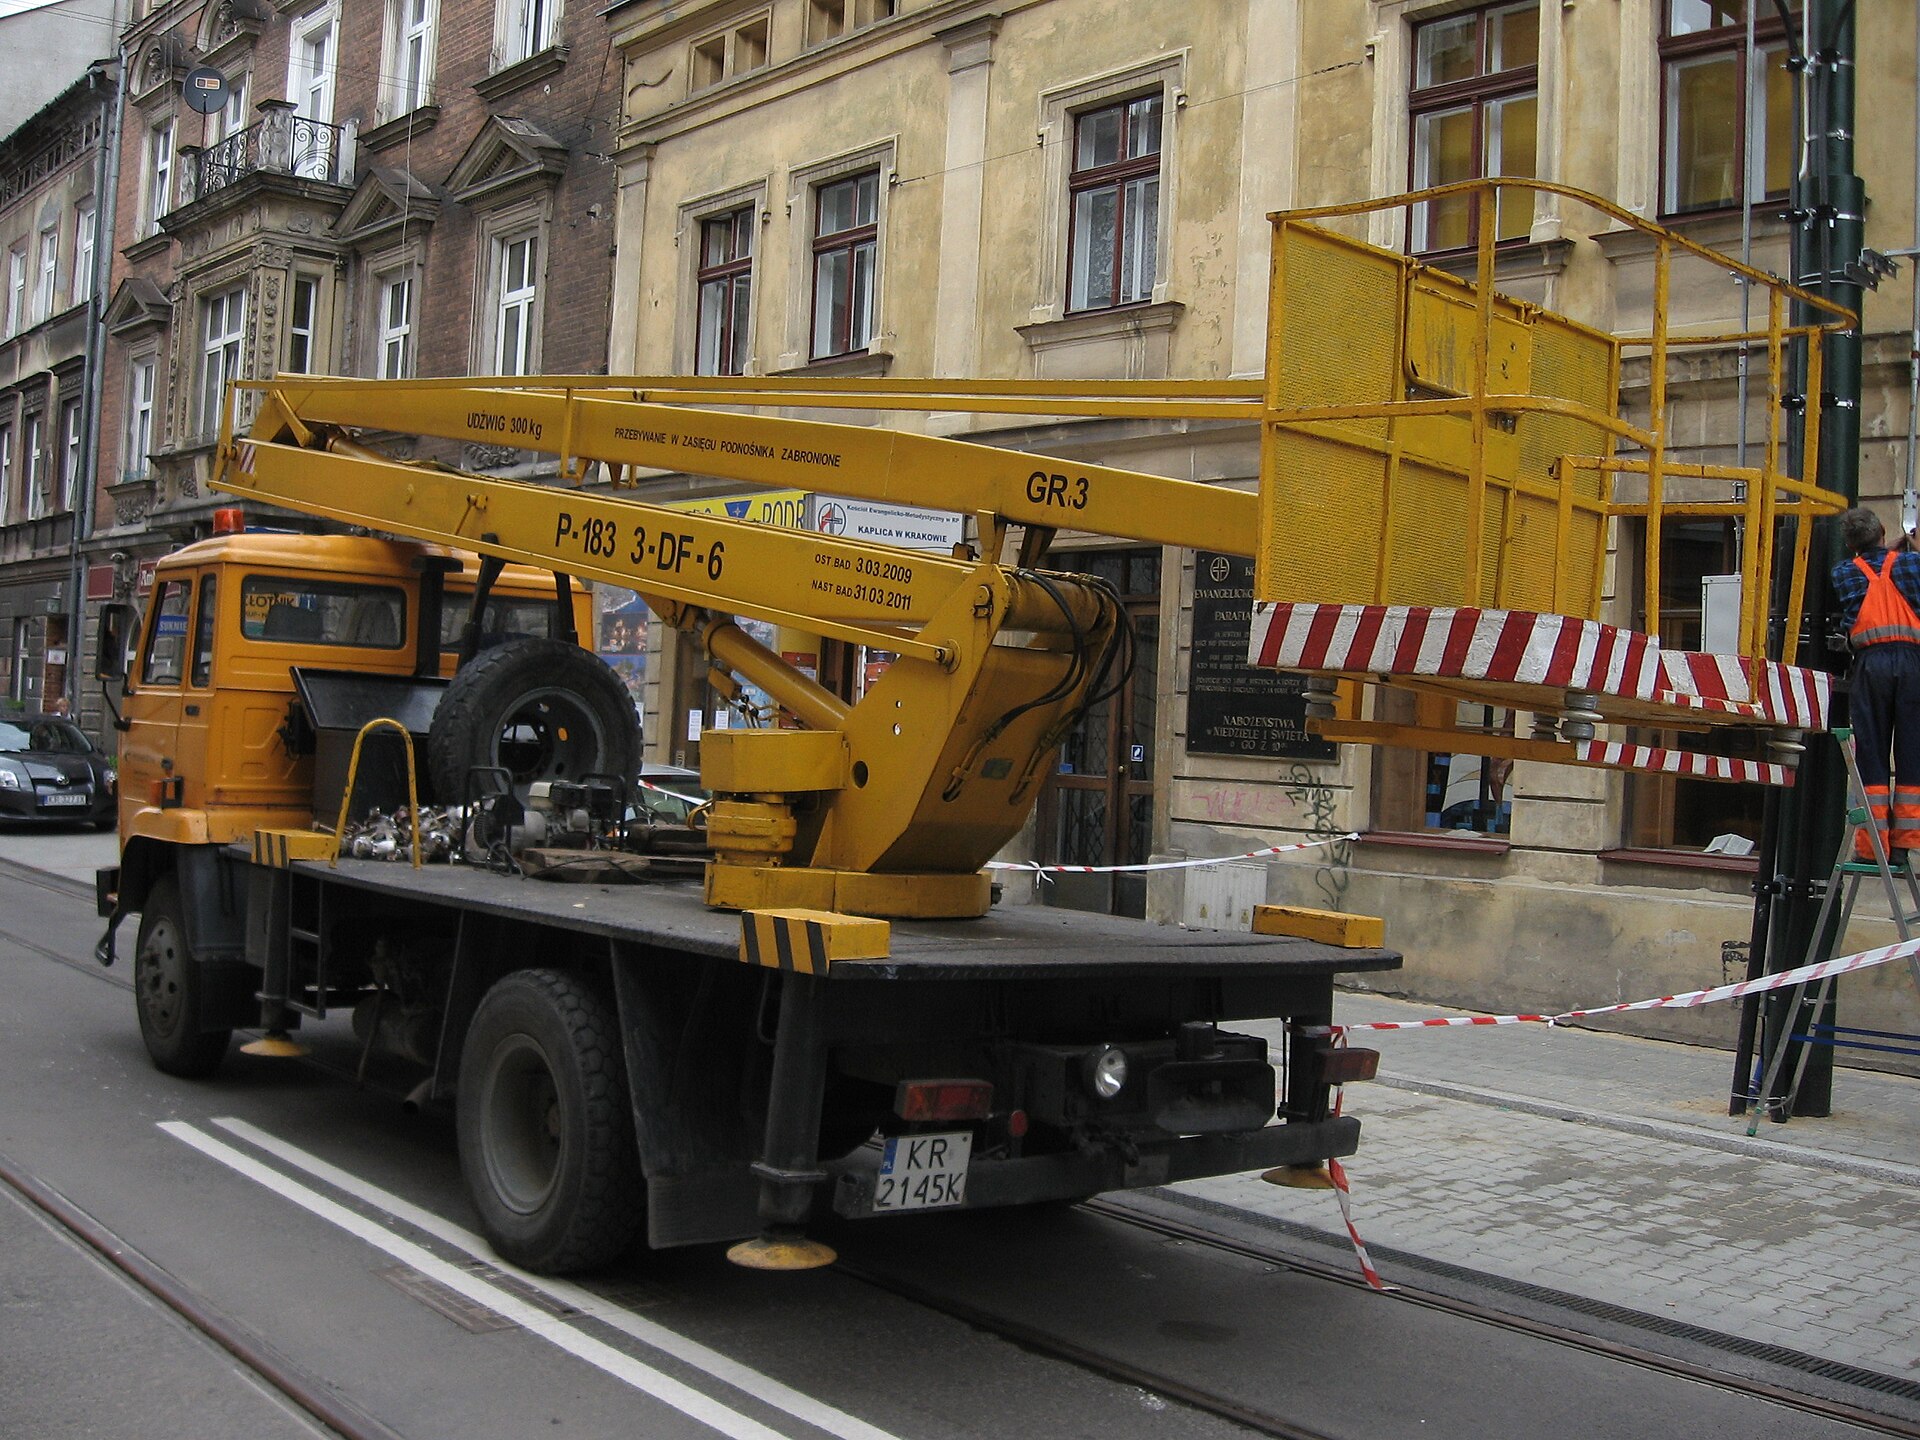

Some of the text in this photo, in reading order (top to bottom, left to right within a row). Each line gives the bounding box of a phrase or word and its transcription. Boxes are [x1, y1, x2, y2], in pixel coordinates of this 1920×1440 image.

[510, 417, 528, 434] 300
[529, 418, 542, 440] kg
[614, 427, 841, 468] PRZEBYWANIE W ZASIĘGU PODNOŚNIKA ZABRONIONE
[1026, 471, 1089, 510] GR.3
[555, 512, 725, 581] P-183 3-DF-6
[858, 525, 948, 543] KAPLICA W KRAKOWIE
[856, 557, 912, 584] 3.03.2009
[854, 584, 912, 611] 31.03.2011
[1213, 726, 1260, 740] NIEDZIELE
[907, 1138, 948, 1170] KR
[877, 1173, 964, 1207] 2145K
